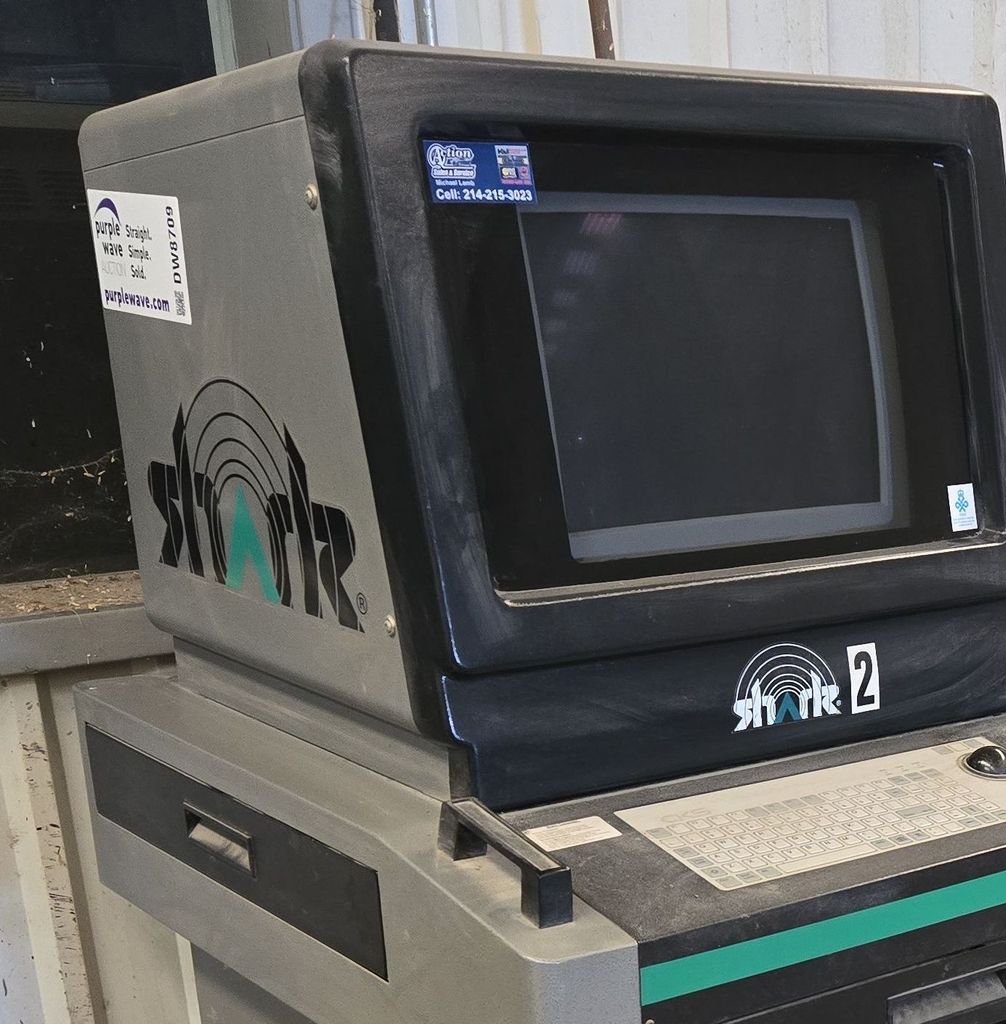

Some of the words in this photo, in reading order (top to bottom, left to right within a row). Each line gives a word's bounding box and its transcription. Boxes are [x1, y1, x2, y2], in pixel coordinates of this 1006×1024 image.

[436, 188, 461, 200] Cell:
[463, 188, 532, 201] 214-215-3023
[95, 218, 120, 240] purple
[125, 224, 152, 243] Straight.
[102, 241, 123, 257] wave
[128, 245, 152, 262] Simple.
[165, 206, 182, 284] DW8709
[130, 265, 146, 279] Sold.
[104, 287, 170, 312] purplewave.com
[853, 651, 876, 707] 2
